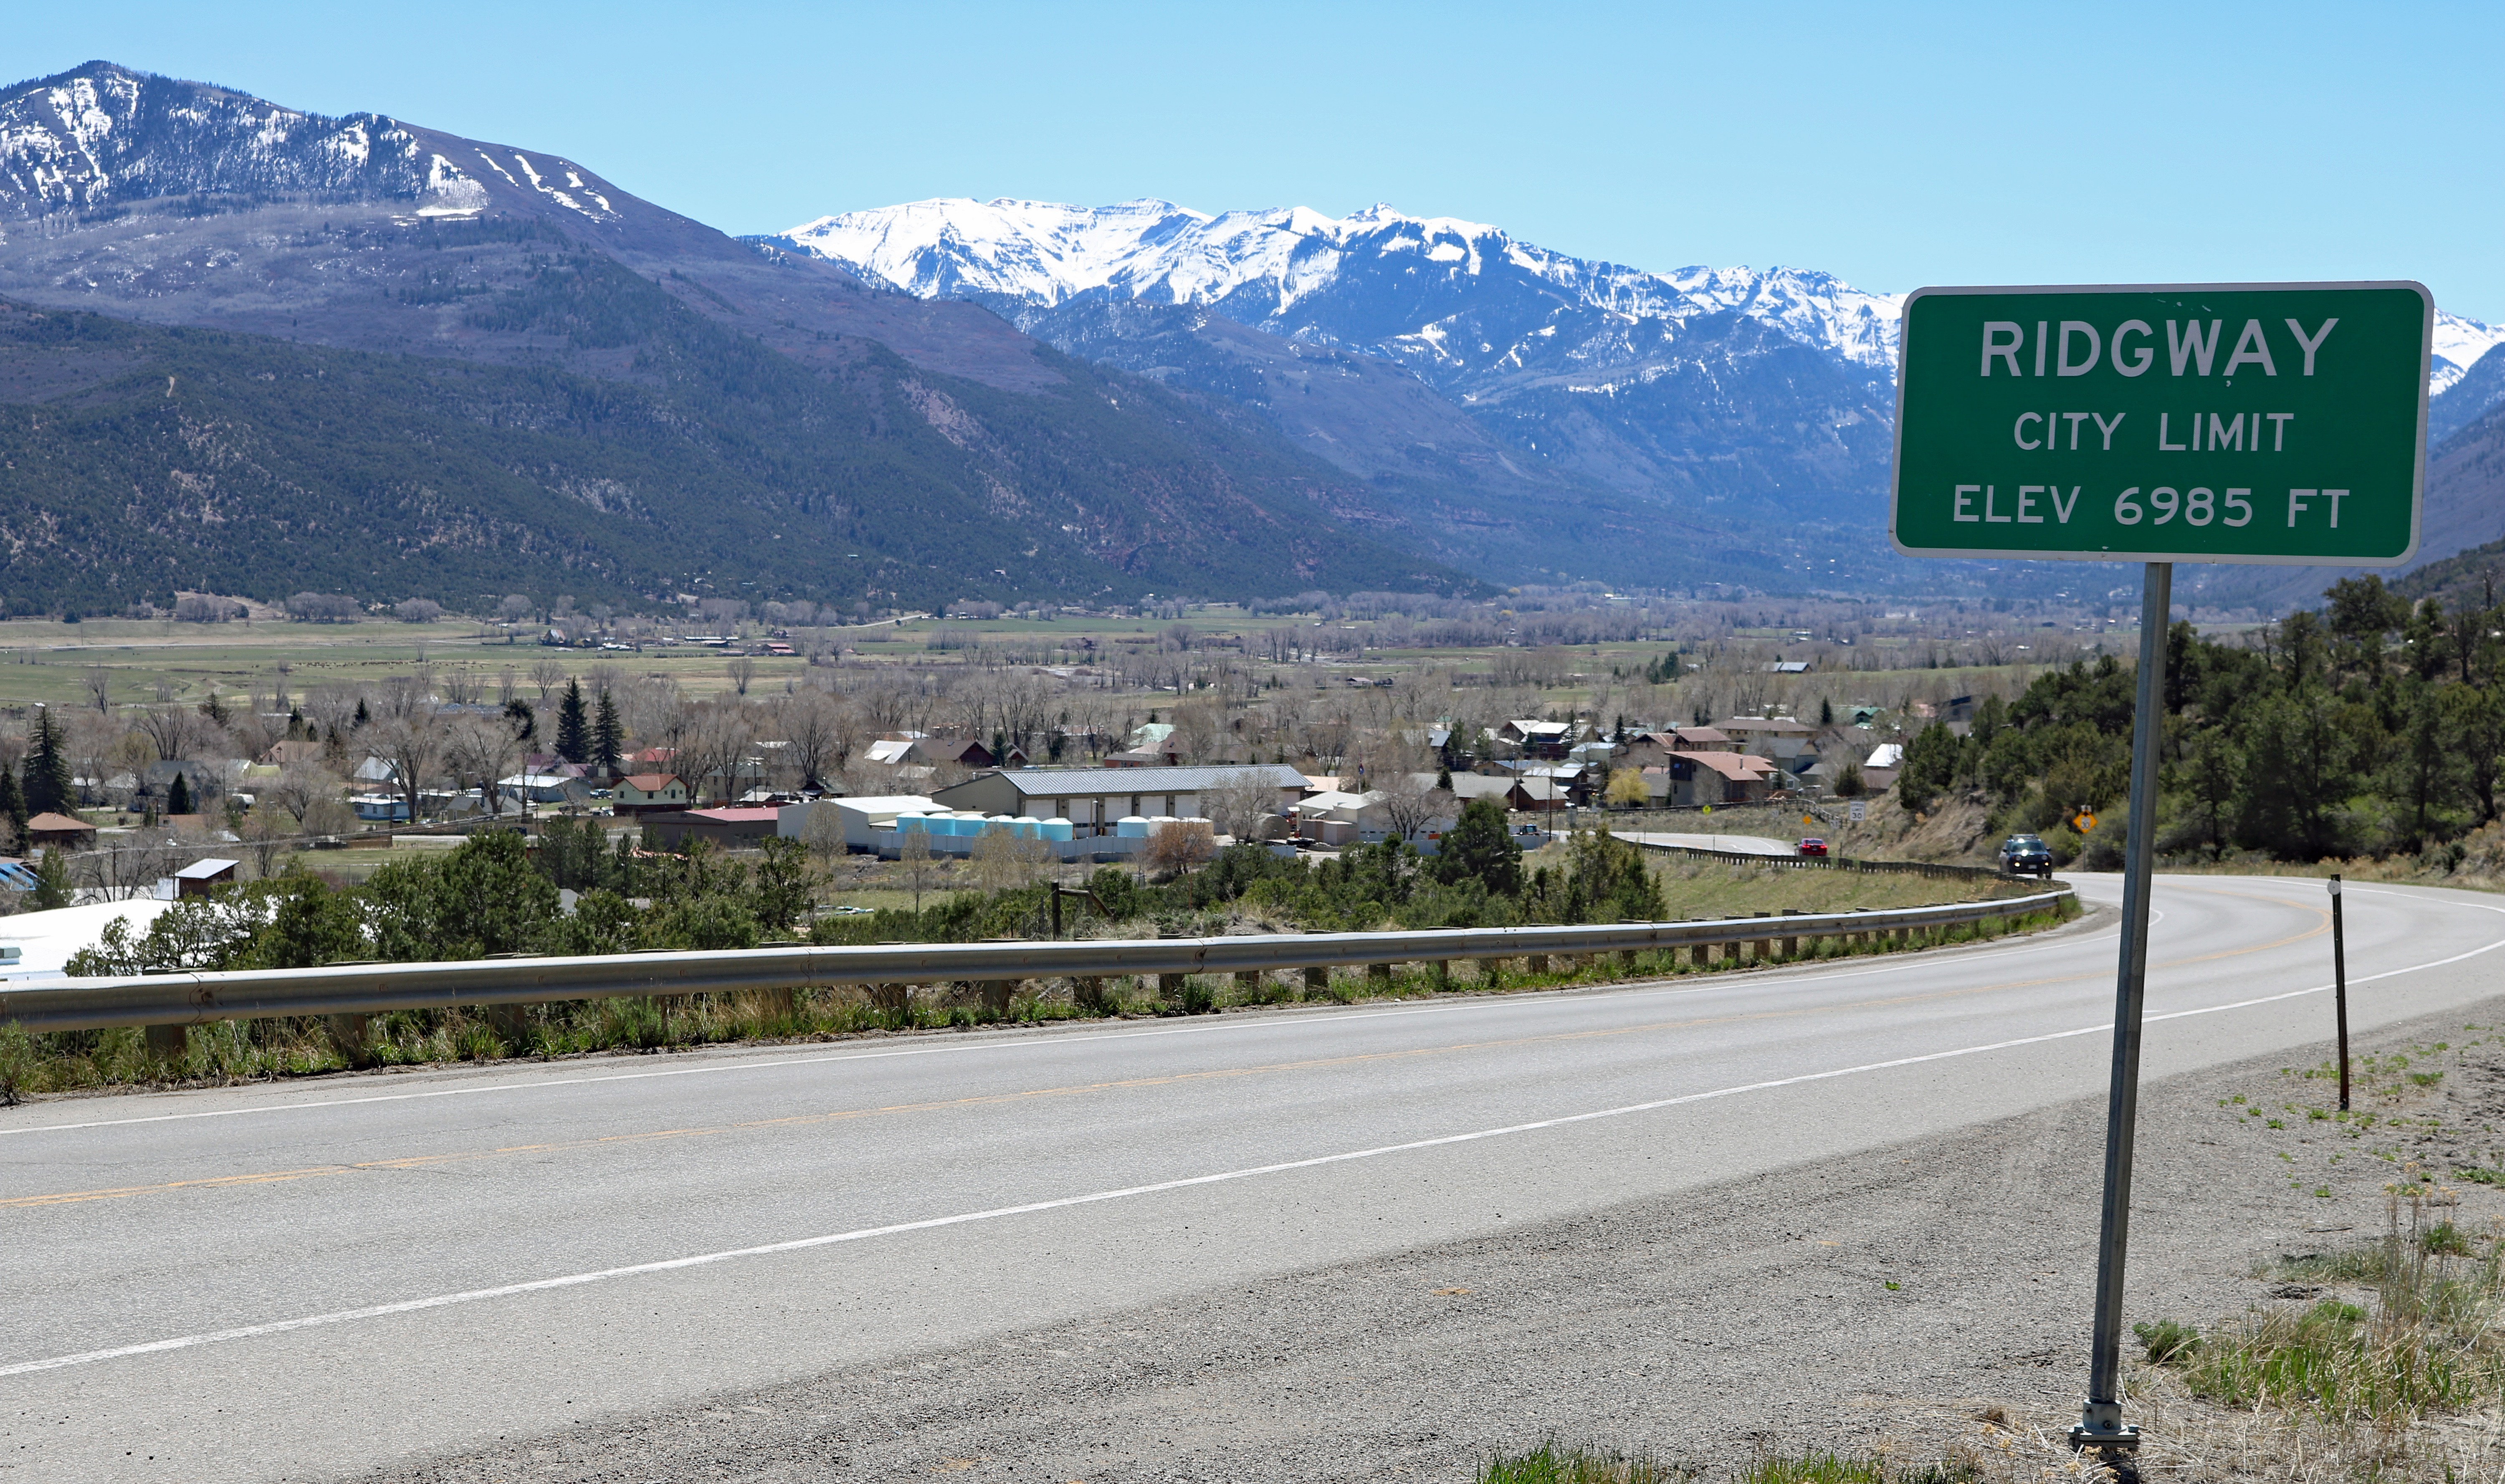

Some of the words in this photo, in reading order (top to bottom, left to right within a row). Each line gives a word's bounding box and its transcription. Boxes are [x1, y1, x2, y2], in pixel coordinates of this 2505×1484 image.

[1981, 318, 2339, 377] RIDGWAY
[2014, 412, 2125, 450] CITY
[2159, 413, 2294, 452] LIMIT
[1953, 485, 2081, 523] ELEV
[2115, 487, 2252, 527] 6985
[2288, 489, 2350, 528] FT
